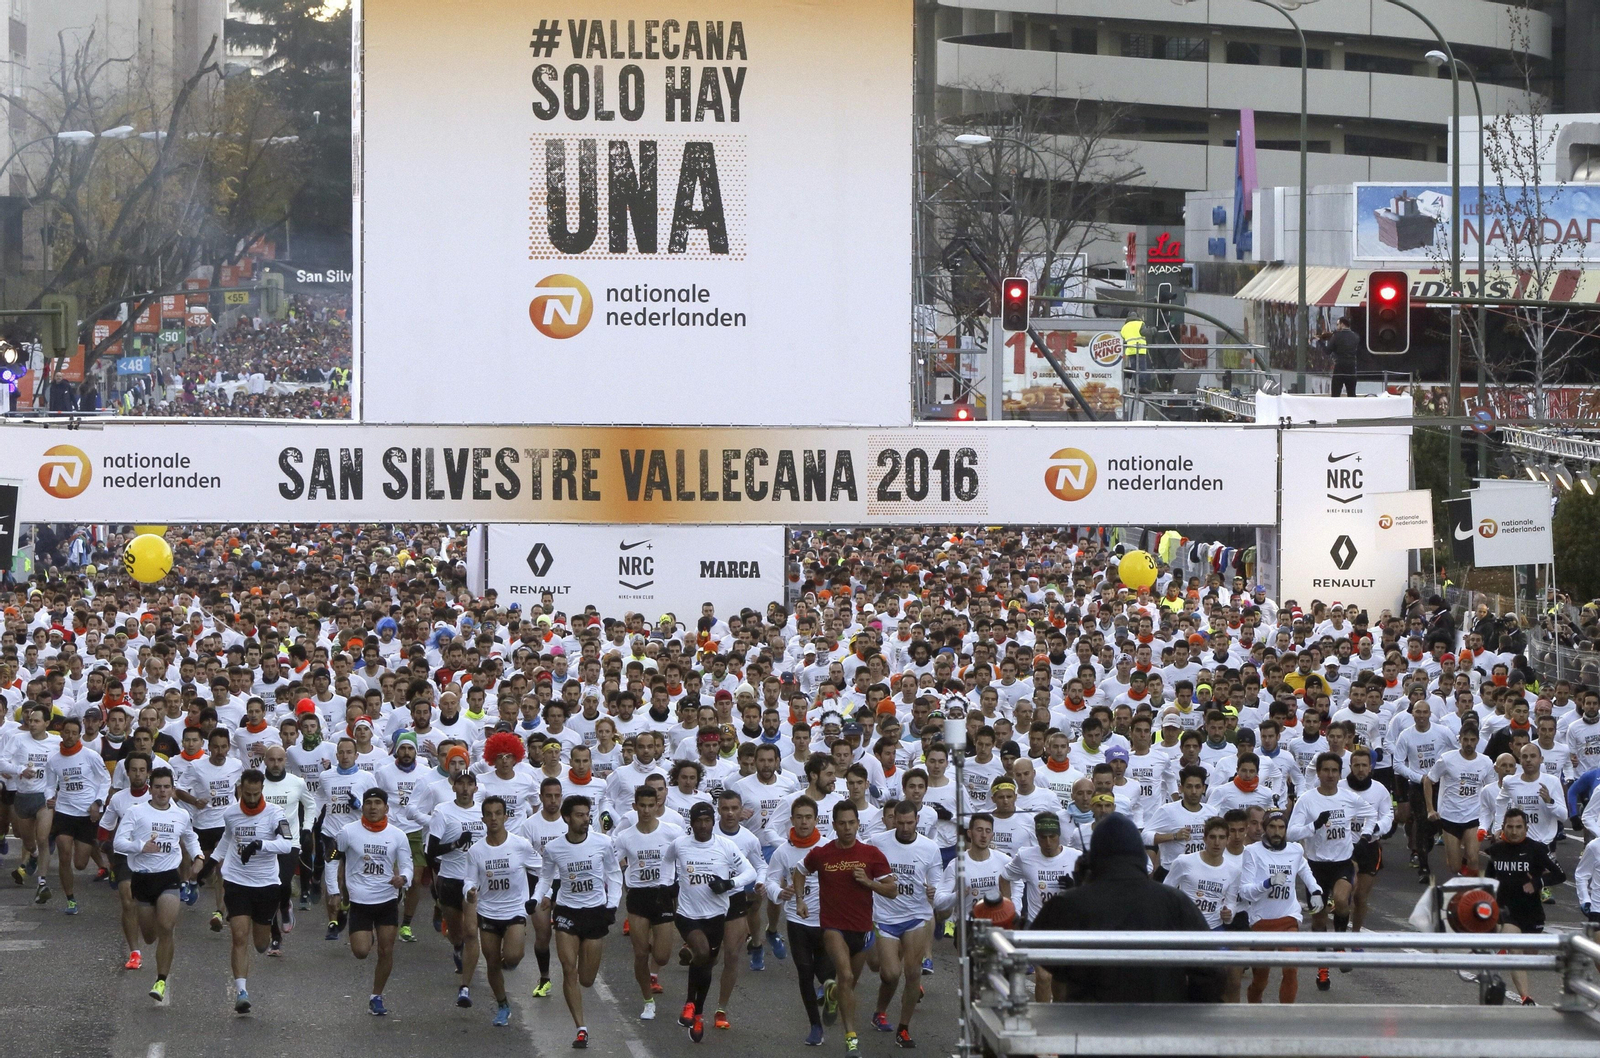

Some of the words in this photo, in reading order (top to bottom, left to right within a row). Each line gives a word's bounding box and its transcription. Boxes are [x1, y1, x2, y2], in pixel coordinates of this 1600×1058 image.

[529, 19, 747, 60] #VALLECANA
[532, 63, 645, 121] SOLO
[665, 66, 747, 122] HAY
[545, 139, 729, 254] UNA
[1148, 232, 1181, 256] La
[297, 270, 322, 283] San
[326, 270, 354, 283] Silv
[606, 284, 710, 303] nationale
[1350, 277, 1366, 298] T.G.I.
[606, 307, 746, 326] nederlanden
[1093, 338, 1120, 351] BURGER
[1094, 345, 1122, 360] KING
[103, 453, 190, 468] nationale
[1108, 455, 1194, 471] nationale
[103, 472, 220, 488] nederlanden
[278, 447, 363, 500] SAN
[382, 447, 600, 501] SILVESTRE
[620, 448, 858, 502] VALLECANA
[877, 448, 980, 502] 2016
[1327, 469, 1363, 488] NRC
[1108, 475, 1223, 490] nederlanden
[1502, 526, 1546, 534] nederlanden
[619, 556, 654, 576] NRC
[700, 560, 760, 578] MARCA
[1313, 578, 1375, 588] RENAULT
[510, 586, 572, 594] RENAULT
[36, 770, 44, 778] 16
[66, 782, 84, 791] 2016
[306, 782, 319, 792] 016
[1140, 786, 1152, 796] 016
[212, 796, 229, 808] 2016
[332, 804, 350, 814] 2016
[1525, 814, 1538, 824] 016
[1326, 829, 1345, 840] 2016
[156, 842, 171, 853] 016
[364, 863, 384, 874] 2016
[640, 869, 660, 880] 2016
[488, 878, 510, 890] 2016
[571, 880, 594, 892] 2016
[898, 884, 914, 895] 016
[1268, 886, 1290, 900] 2016
[1196, 900, 1218, 912] 2016
